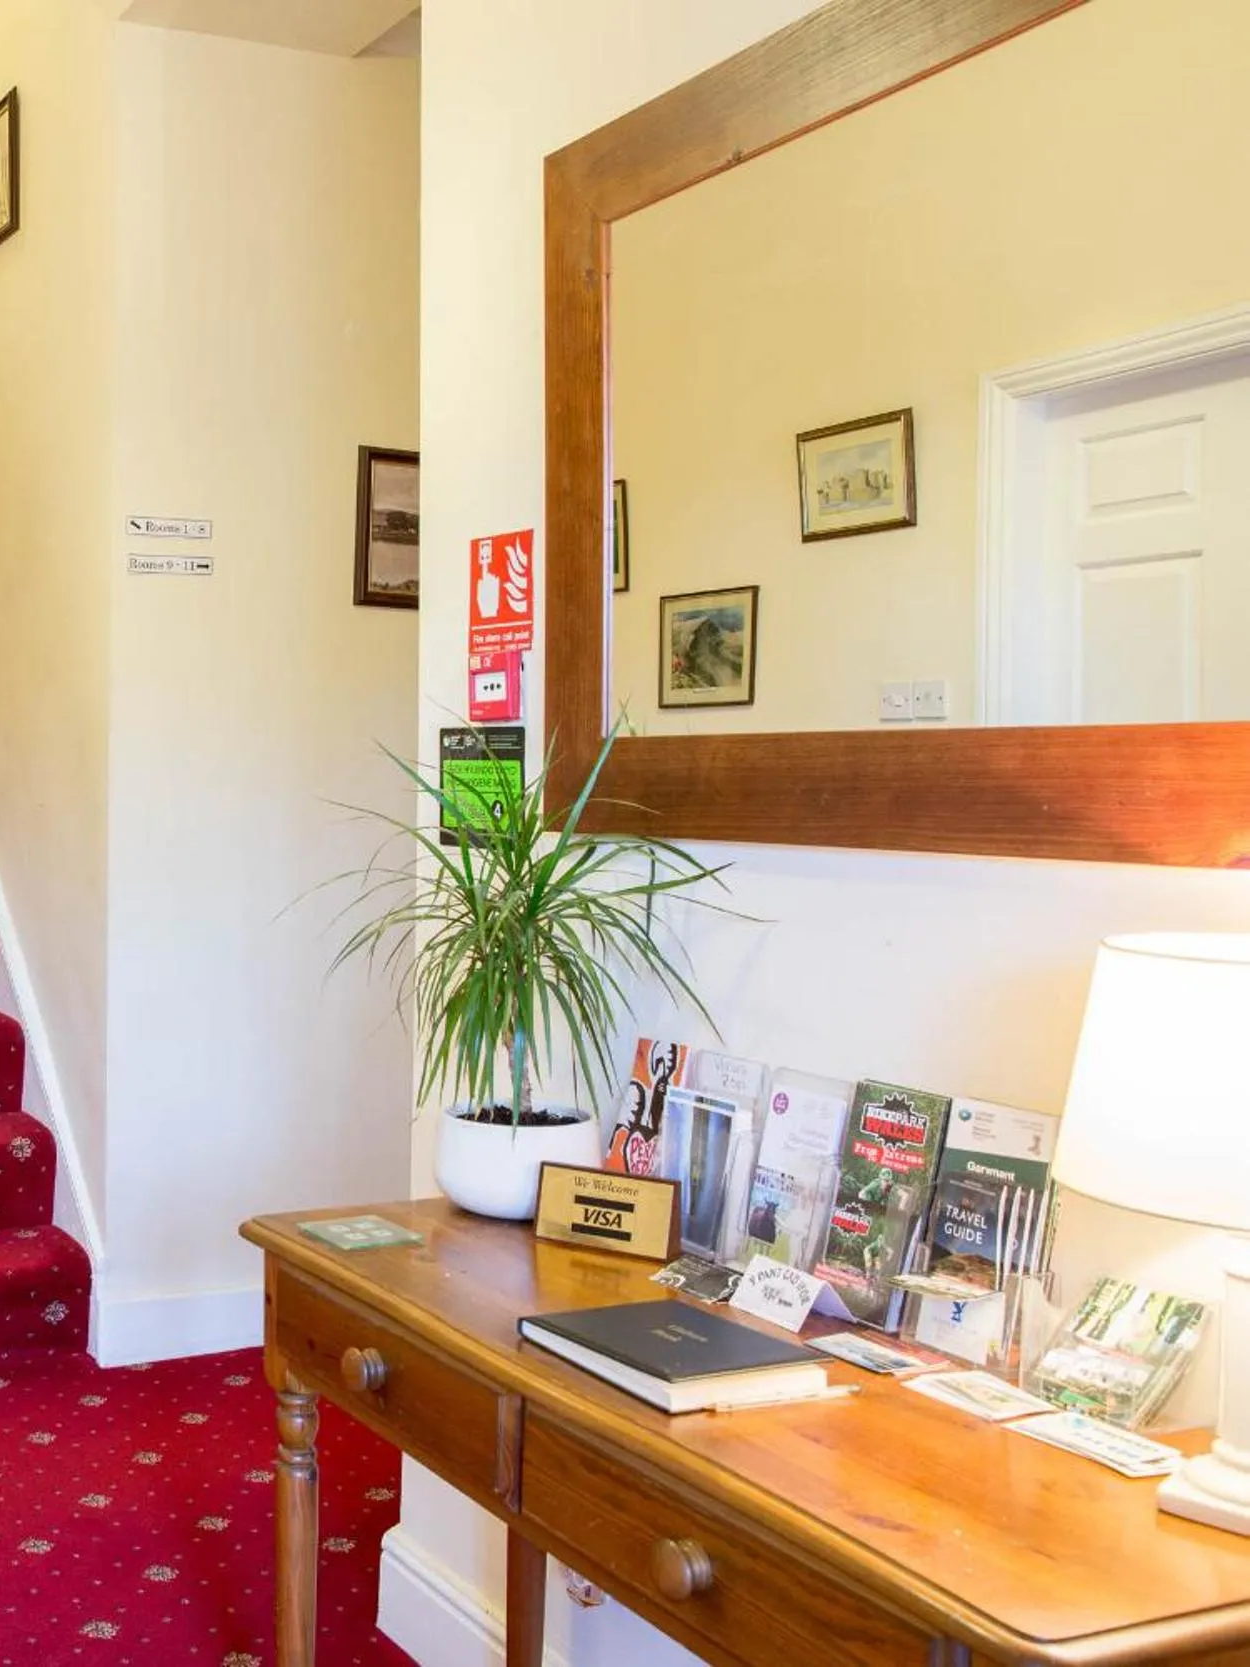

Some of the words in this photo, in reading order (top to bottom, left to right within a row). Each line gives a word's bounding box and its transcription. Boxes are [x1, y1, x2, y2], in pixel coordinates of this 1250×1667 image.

[129, 558, 164, 571] Rooms
[574, 1176, 591, 1189] We
[593, 1180, 640, 1197] Welcome
[583, 1208, 623, 1229] VISA
[946, 1205, 988, 1229] TRAVEL
[944, 1223, 983, 1245] GUIDE
